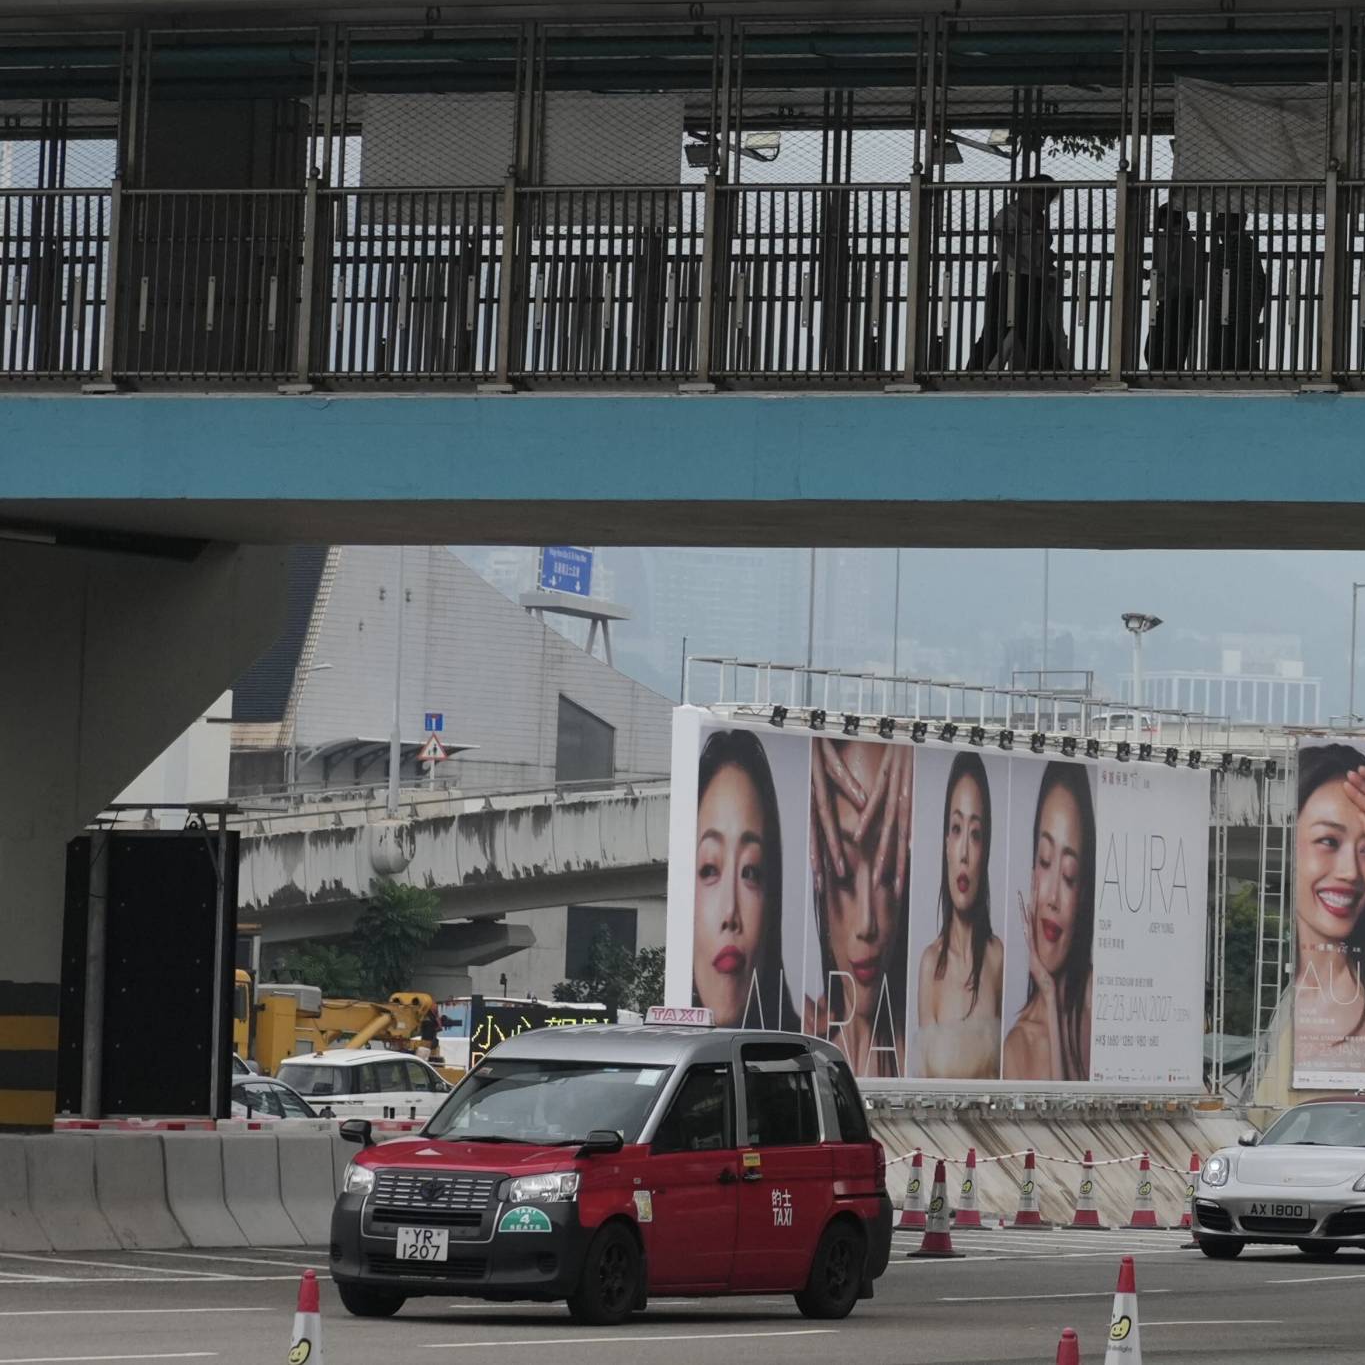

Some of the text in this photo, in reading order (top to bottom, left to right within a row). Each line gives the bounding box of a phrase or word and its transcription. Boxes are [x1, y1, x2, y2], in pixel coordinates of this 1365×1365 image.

[1099, 832, 1191, 916] AURA
[651, 1008, 705, 1023] TAXI
[772, 1189, 793, 1207] 的士
[1250, 1202, 1267, 1215] AX
[520, 1214, 531, 1225] 4
[773, 1208, 793, 1226] TAXI
[413, 1229, 434, 1245] YR
[402, 1244, 440, 1260] 1207
